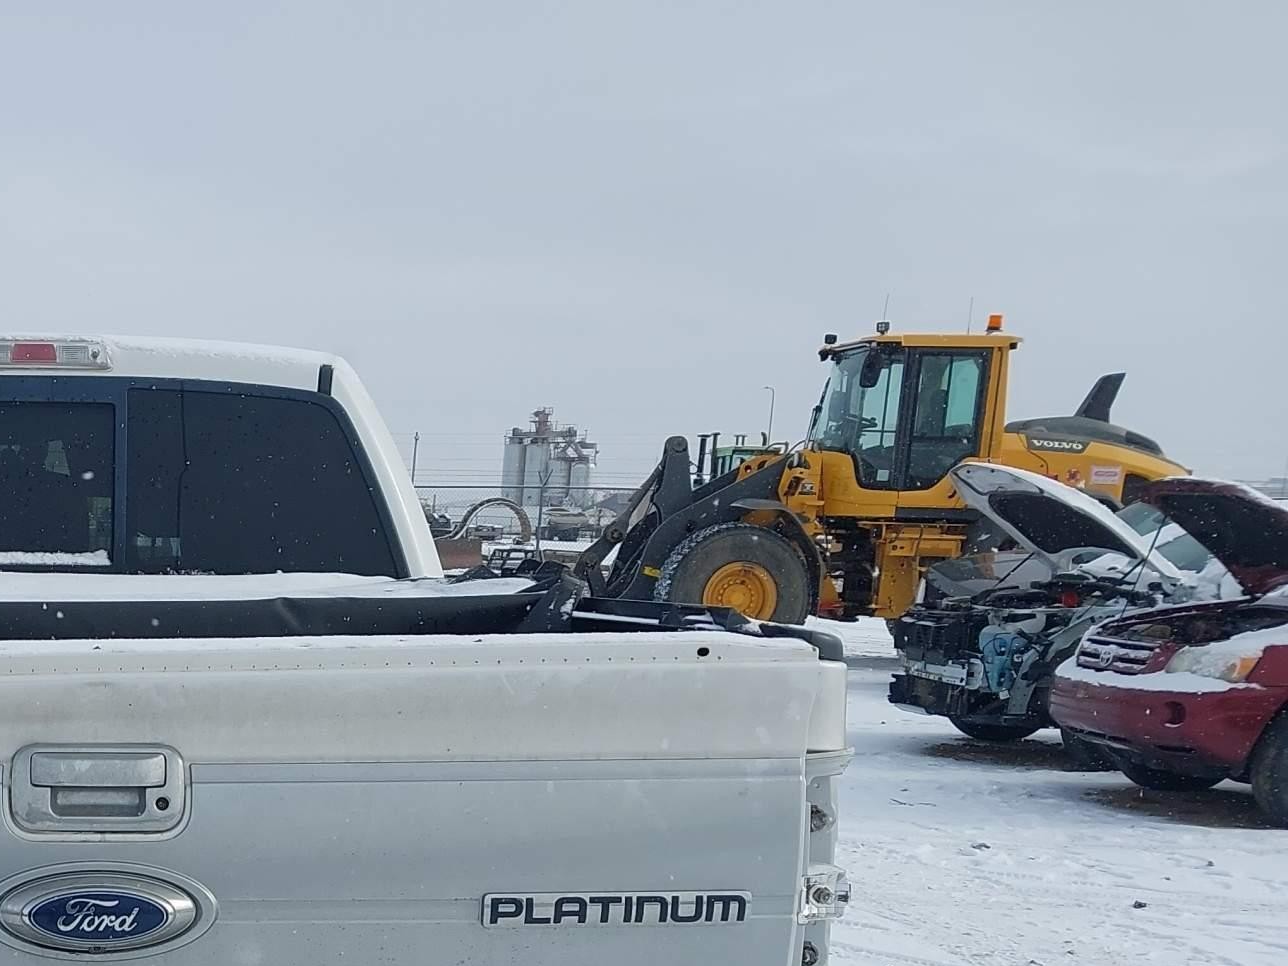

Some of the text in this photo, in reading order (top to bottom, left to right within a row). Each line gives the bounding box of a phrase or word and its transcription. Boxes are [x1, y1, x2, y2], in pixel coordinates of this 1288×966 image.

[1031, 439, 1084, 451] VOLVO
[56, 898, 140, 932] Ford
[488, 894, 747, 925] PLATINUM
